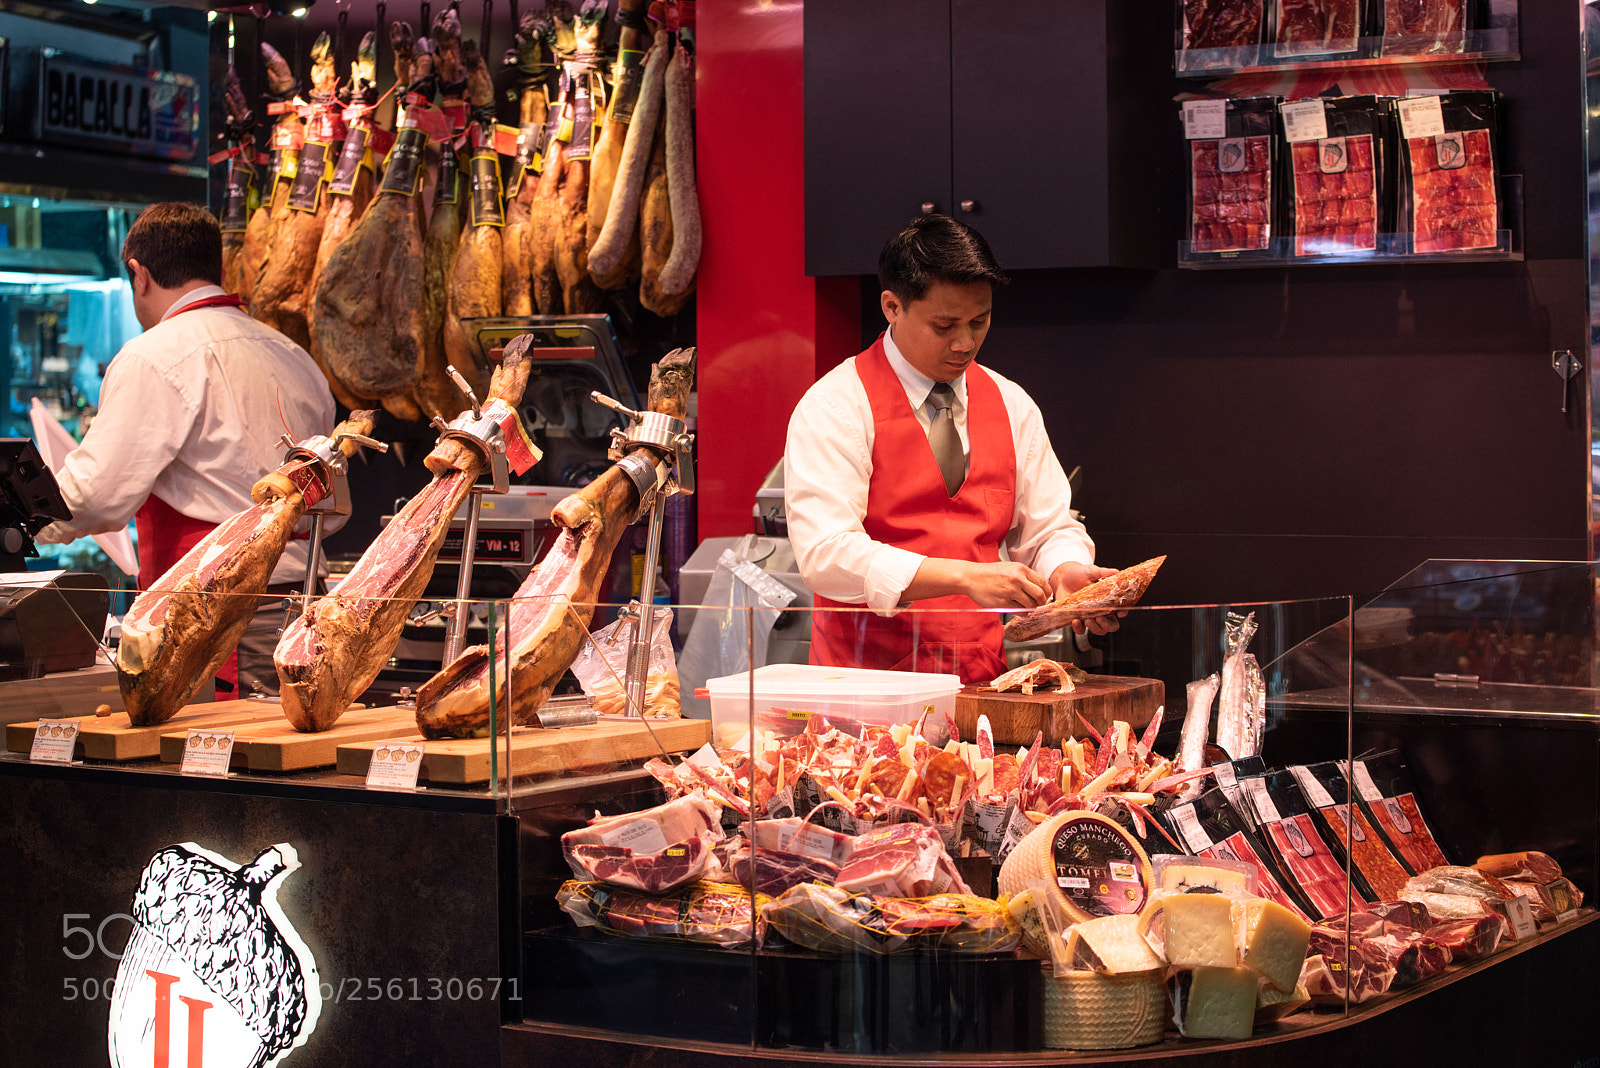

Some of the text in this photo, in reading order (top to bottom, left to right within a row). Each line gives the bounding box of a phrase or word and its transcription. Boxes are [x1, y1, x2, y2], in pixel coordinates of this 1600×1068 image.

[486, 539, 501, 551] VM
[509, 540, 520, 552] 12
[1057, 825, 1078, 849] QUESO
[1080, 823, 1132, 856] MANCHEGO
[1076, 833, 1109, 843] CURADO
